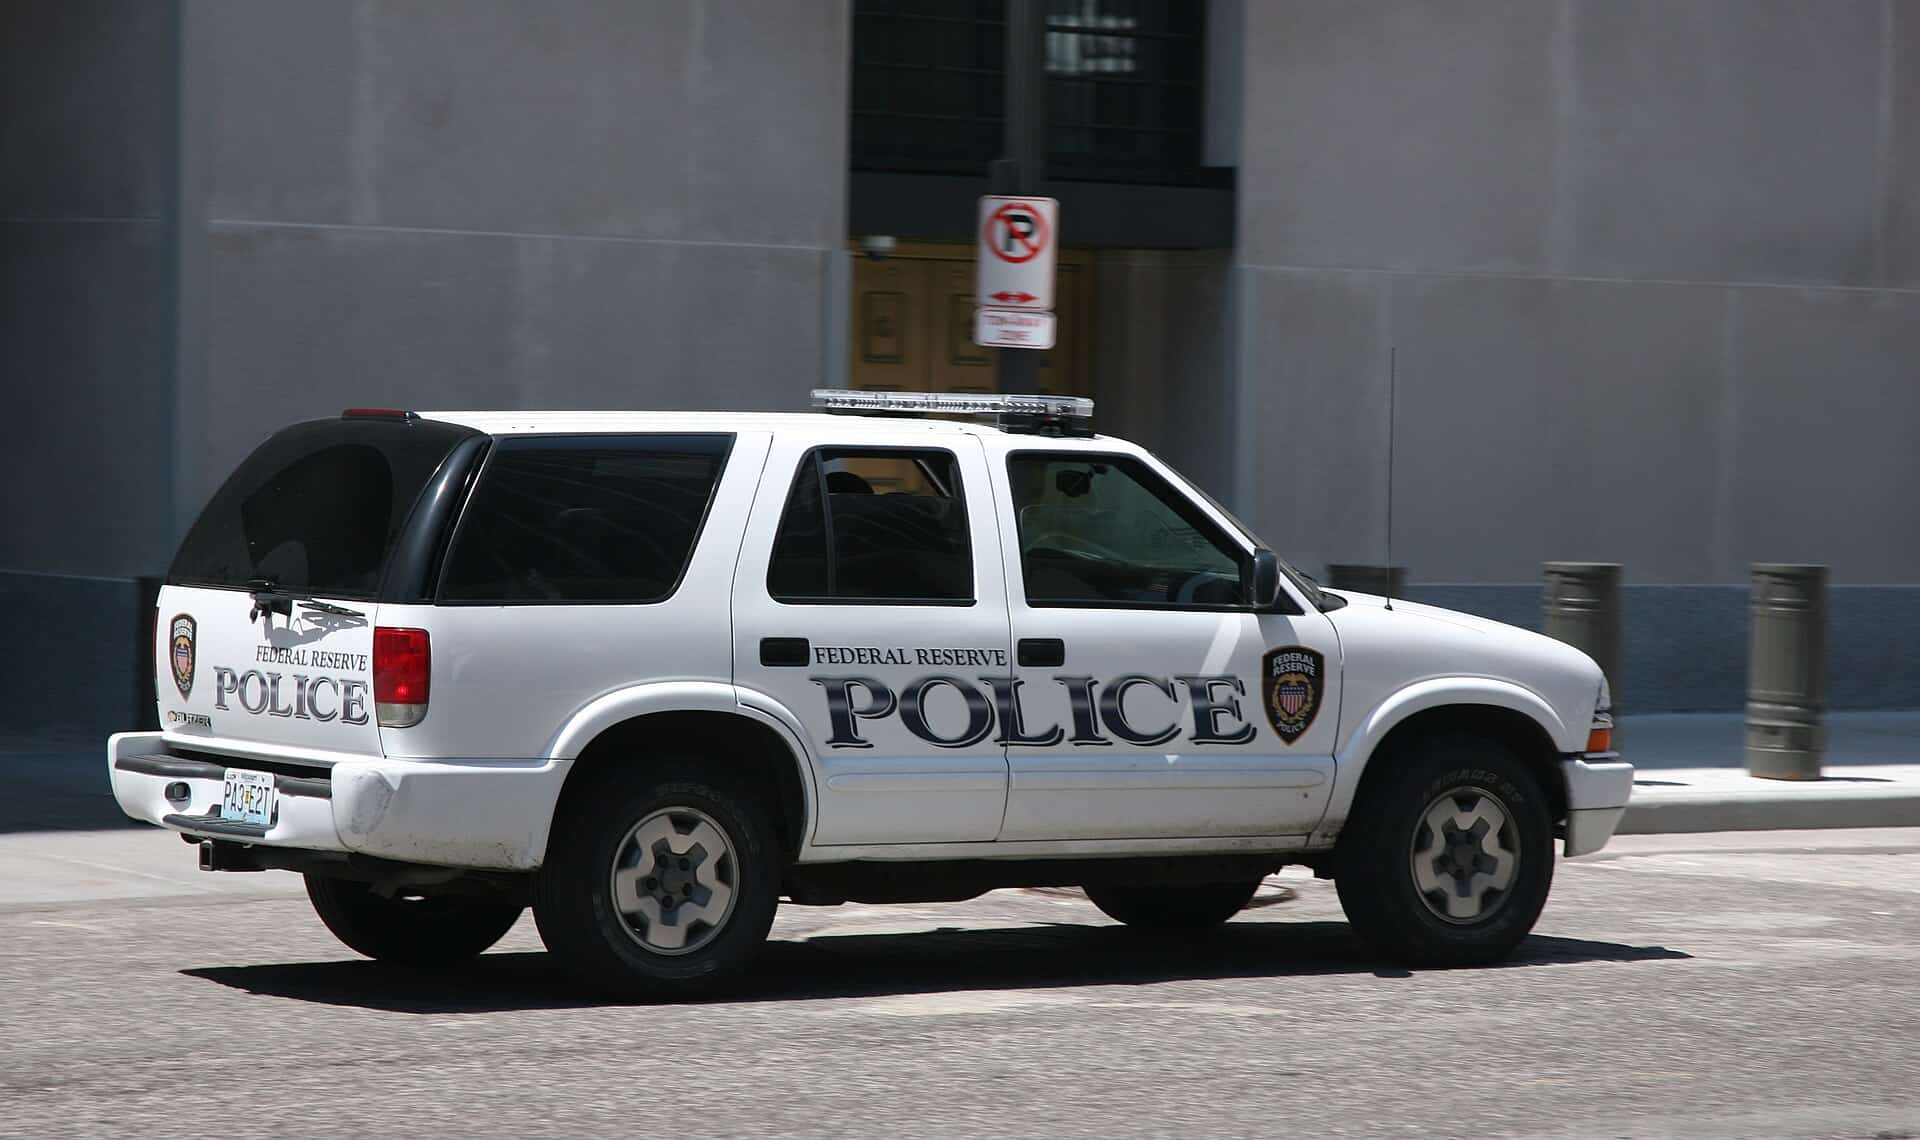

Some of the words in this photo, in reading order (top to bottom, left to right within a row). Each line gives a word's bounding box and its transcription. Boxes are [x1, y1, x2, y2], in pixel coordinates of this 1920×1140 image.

[256, 645, 308, 666] FEDERAL
[311, 650, 368, 671] RESERVE
[813, 647, 912, 665] FEDERAL
[915, 649, 1007, 666] RESERVE
[1273, 652, 1315, 667] FEDERAL
[1273, 661, 1315, 677] RESERVE
[213, 666, 369, 726] POLICE
[809, 675, 1257, 748] POLICE
